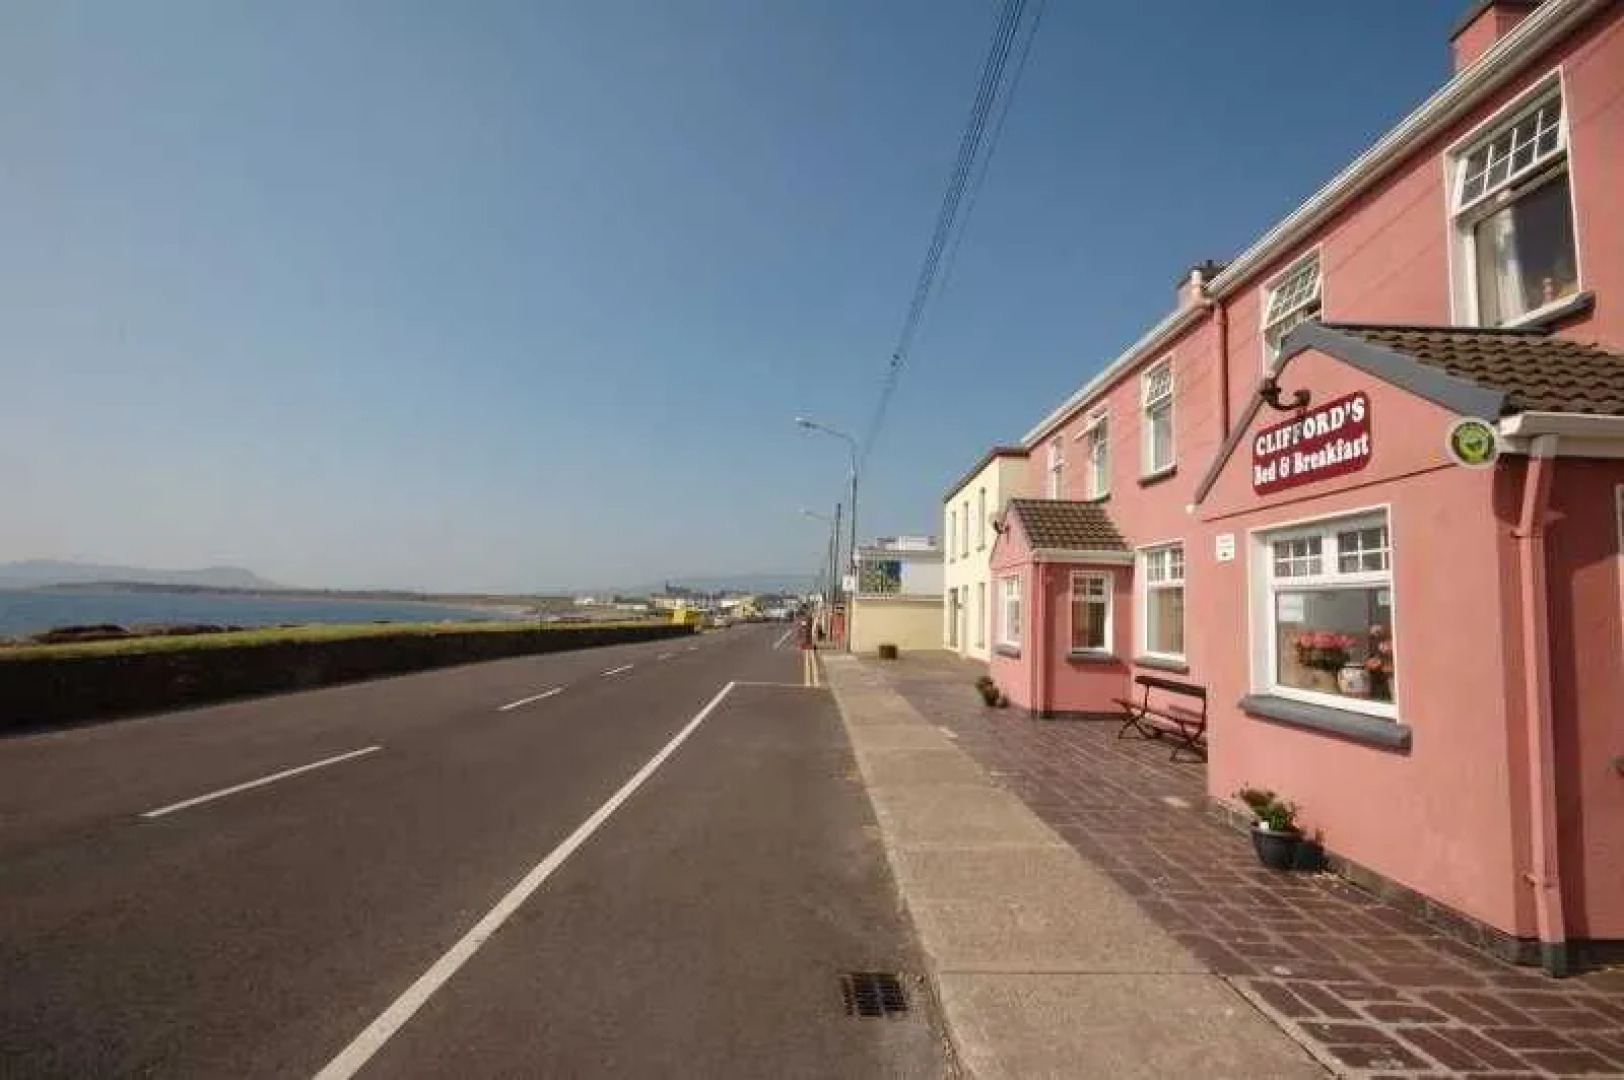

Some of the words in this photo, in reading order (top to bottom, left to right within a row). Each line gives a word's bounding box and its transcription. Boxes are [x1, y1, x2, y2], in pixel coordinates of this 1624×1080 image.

[1256, 397, 1365, 456] CLIFFORD'S
[1254, 460, 1276, 486] Bed
[1294, 433, 1369, 474] Breakfast
